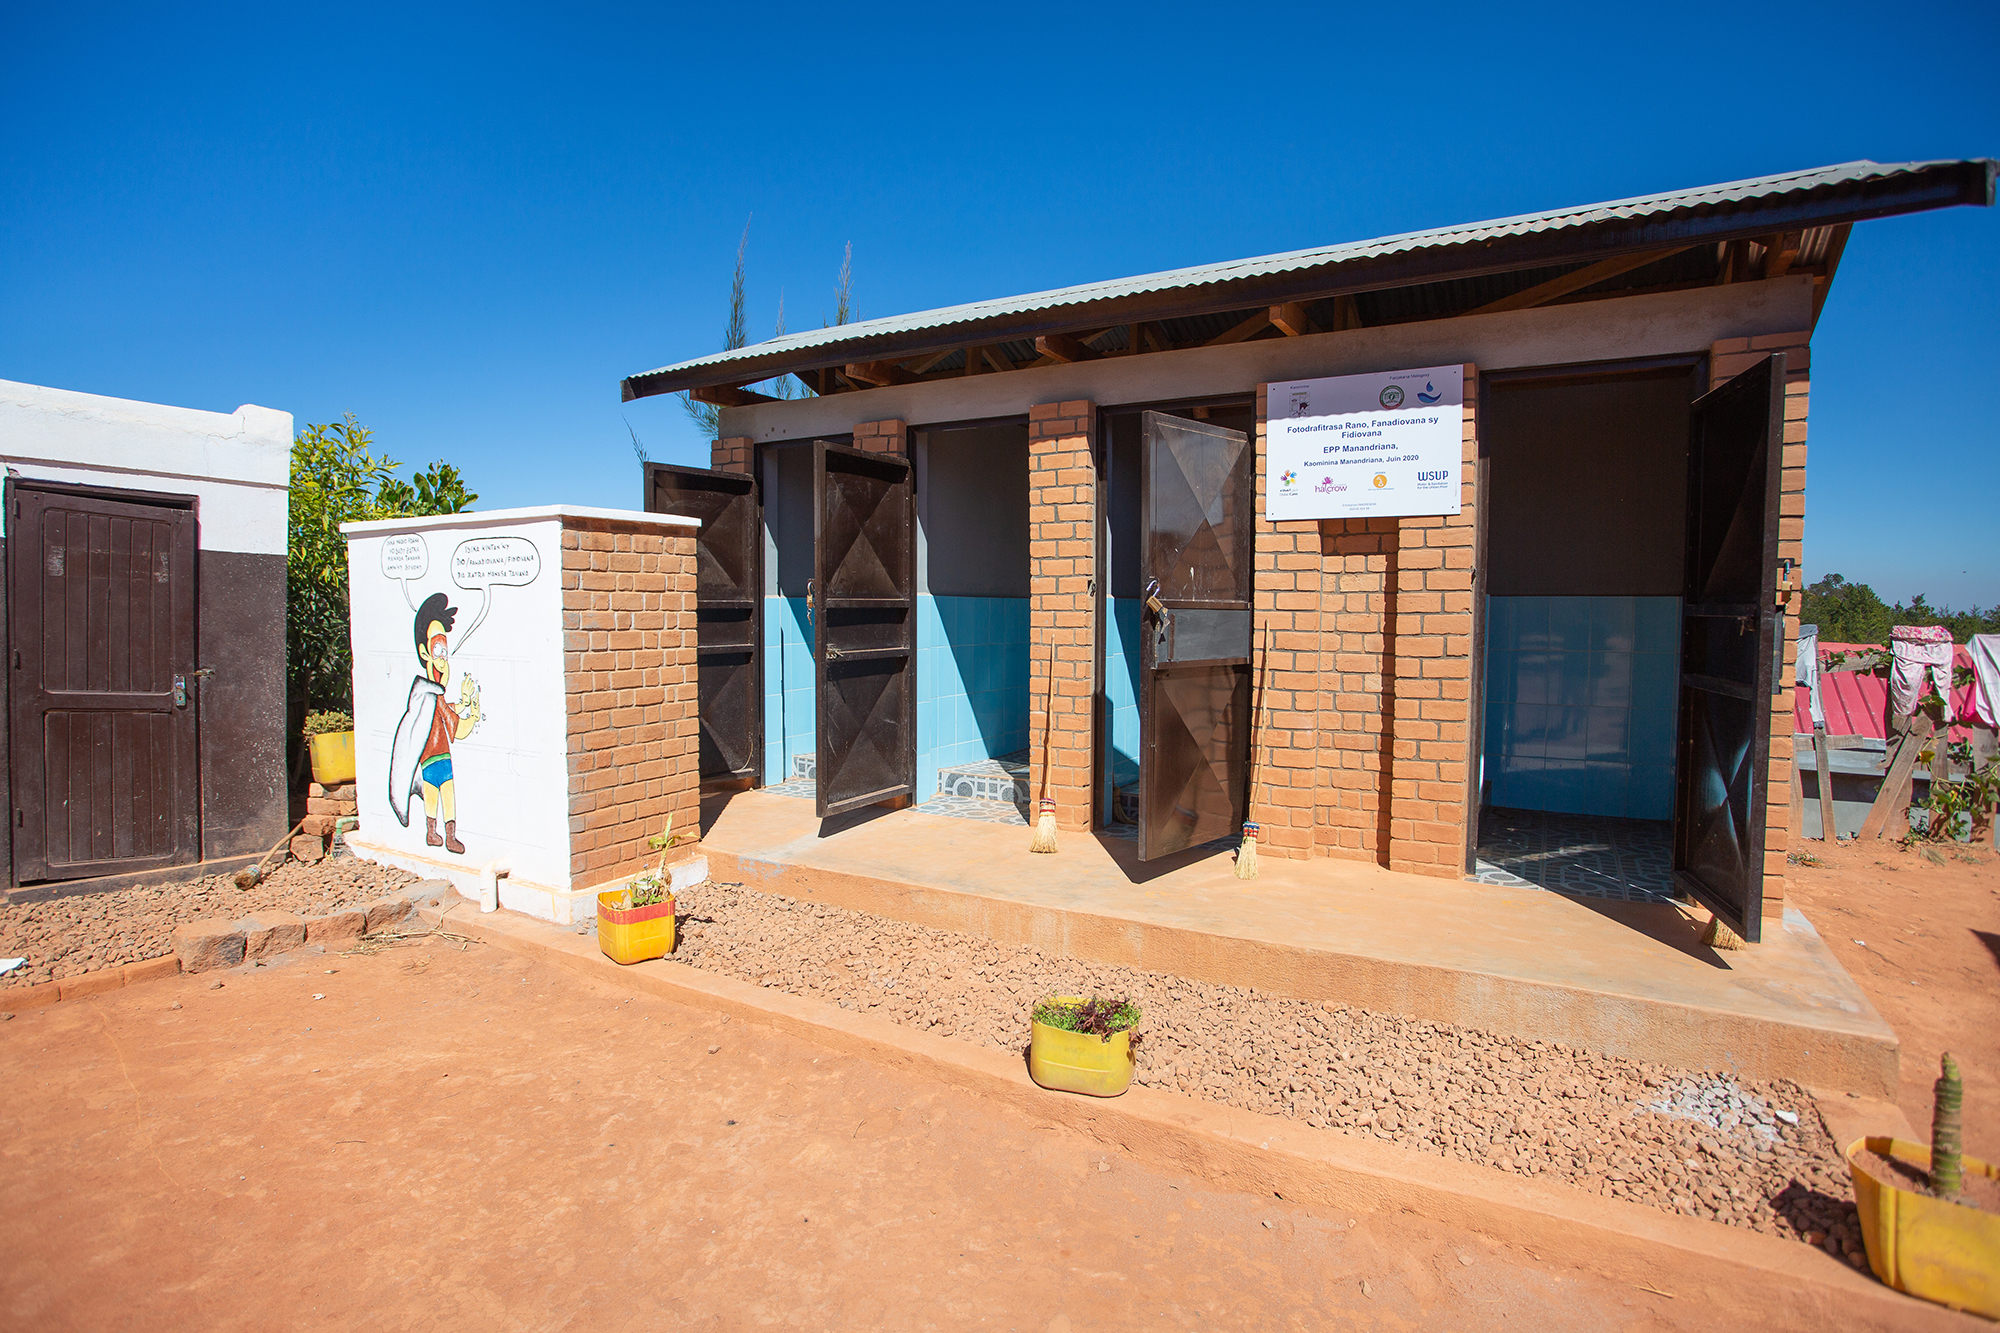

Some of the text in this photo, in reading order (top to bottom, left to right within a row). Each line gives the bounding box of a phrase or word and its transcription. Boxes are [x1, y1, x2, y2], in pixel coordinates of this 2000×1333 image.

[1287, 423, 1343, 434] Fotodrafitrasa
[1372, 418, 1426, 428] Fanadiovana
[1428, 416, 1439, 424] sy
[1342, 430, 1382, 438] Fidiovana
[1342, 443, 1398, 452] Manandriana,
[1304, 459, 1338, 467] Kaominina
[1340, 456, 1384, 465] Manandriana,
[1418, 470, 1448, 481] WSUP
[1314, 484, 1348, 494] halcrow
